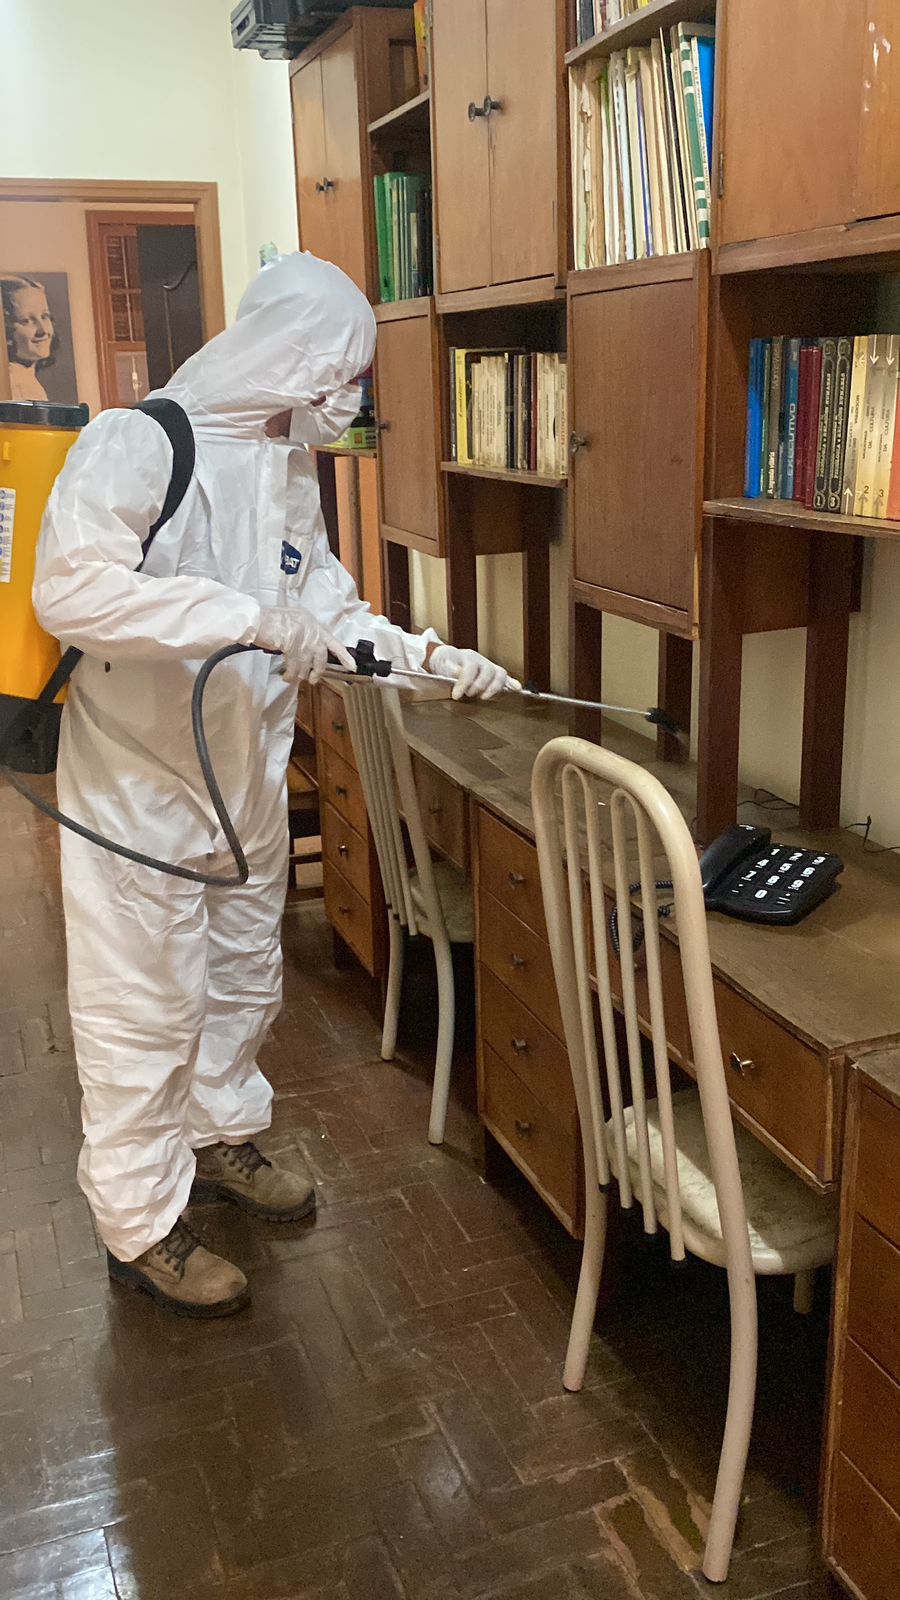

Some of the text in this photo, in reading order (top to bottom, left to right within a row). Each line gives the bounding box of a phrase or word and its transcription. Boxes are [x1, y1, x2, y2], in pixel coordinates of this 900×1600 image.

[864, 485, 869, 494] 2
[879, 489, 885, 497] 3
[771, 848, 780, 856] 1
[791, 852, 803, 860] 2
[814, 856, 826, 864] 3
[757, 859, 769, 867] 4
[780, 863, 793, 872] 5
[803, 867, 816, 875] 6
[768, 875, 780, 884] 8
[793, 879, 805, 888] 9
[754, 889, 768, 899] 0
